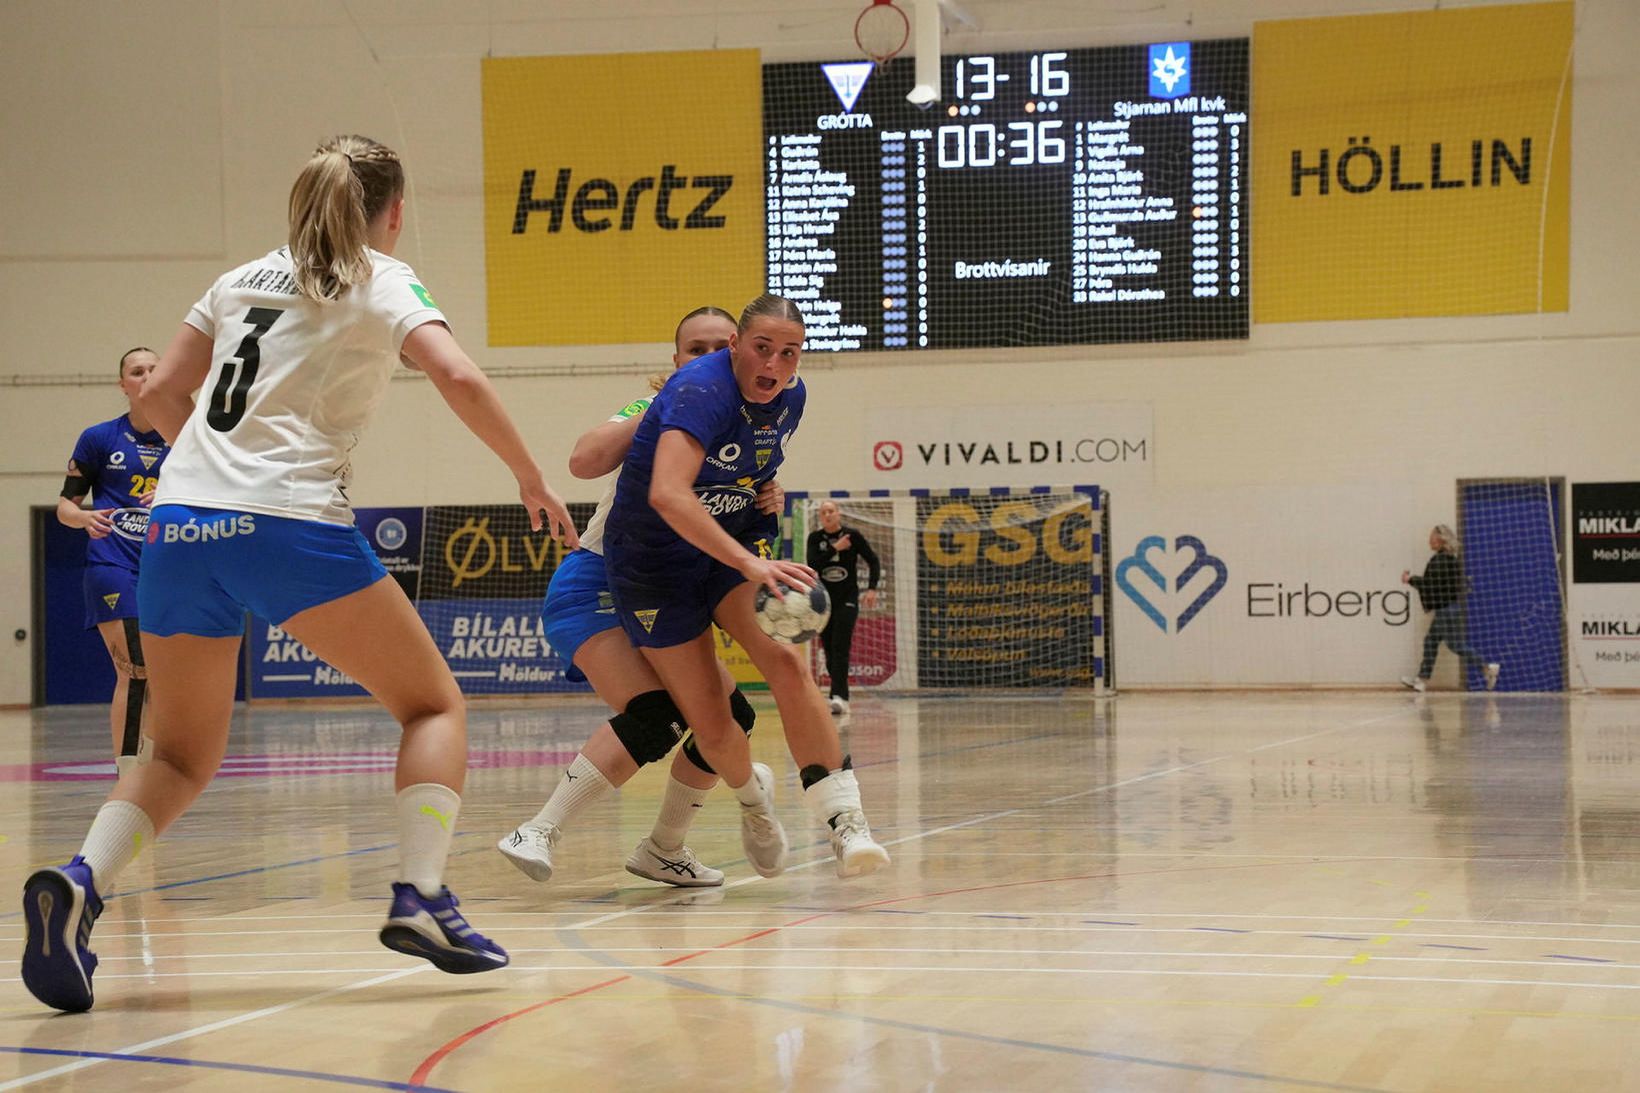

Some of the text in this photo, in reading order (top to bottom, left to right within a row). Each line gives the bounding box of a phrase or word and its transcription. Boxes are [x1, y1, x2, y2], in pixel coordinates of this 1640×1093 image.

[816, 111, 873, 130] GRÓTTA
[1113, 101, 1171, 120] Stjarnan
[1201, 95, 1226, 111] kvk
[938, 120, 1066, 168] 00:36
[1290, 136, 1532, 197] HÖLLIN
[511, 164, 734, 234] Hertz
[955, 258, 1051, 279] Brottvísanir
[206, 306, 286, 433] 3
[705, 456, 738, 472] ORKAN
[917, 438, 1147, 466] VIVALDI.COM
[163, 514, 256, 543] BÓNUS
[923, 502, 1093, 567] GSG
[1247, 582, 1411, 627] Eirberg
[499, 662, 557, 682] Höldur
